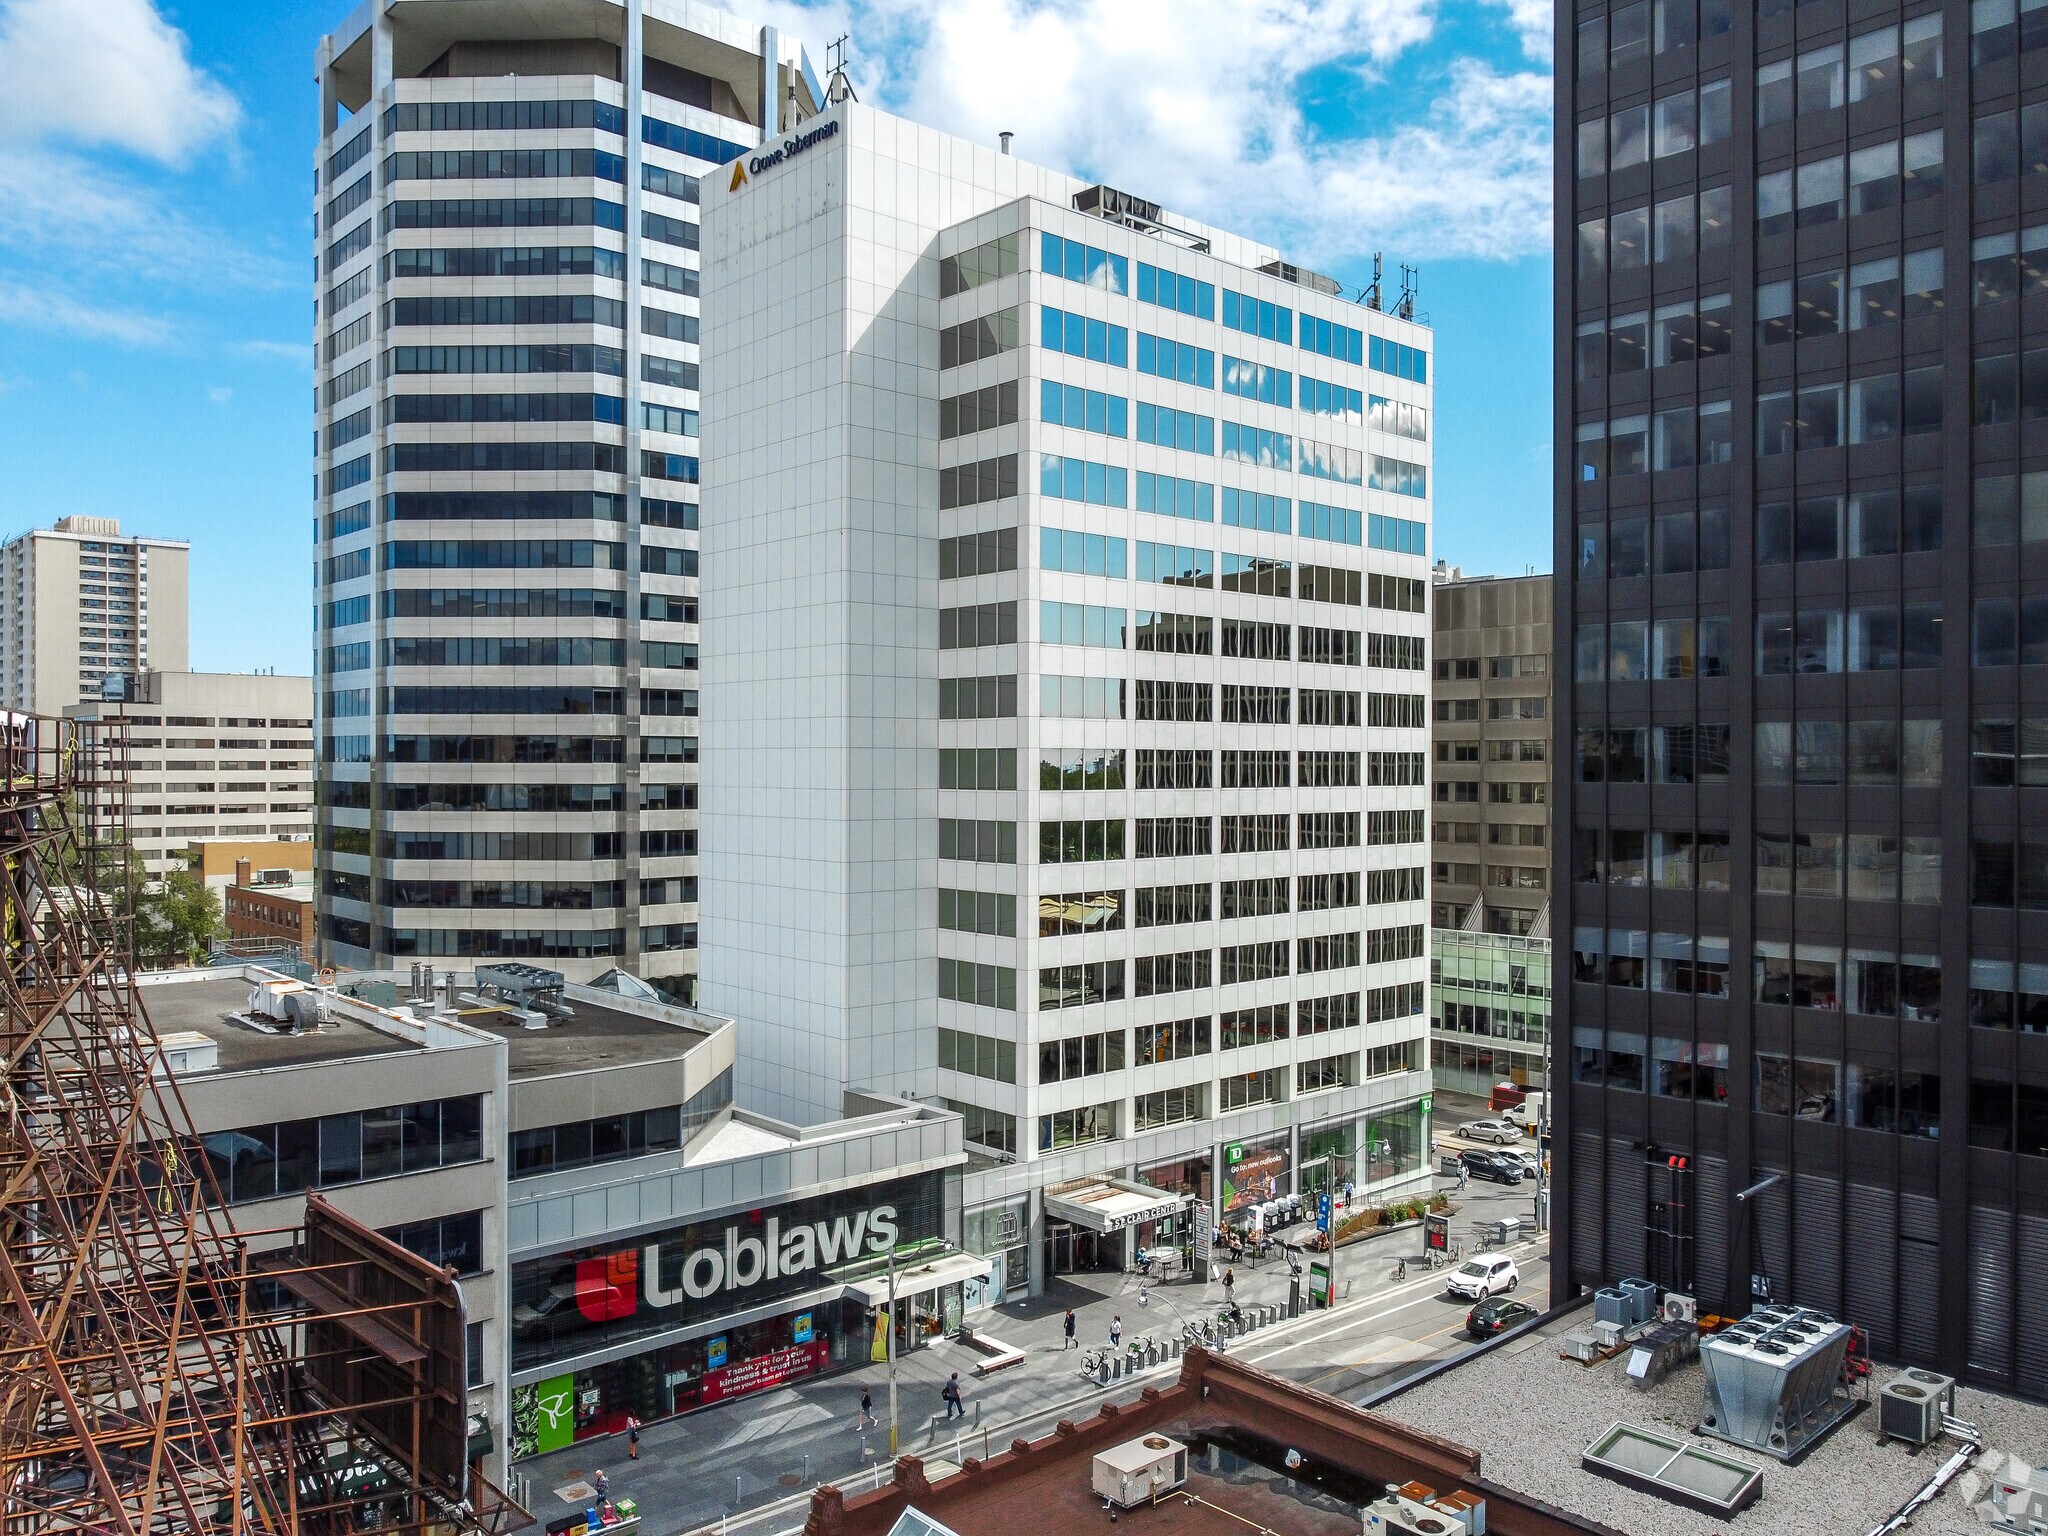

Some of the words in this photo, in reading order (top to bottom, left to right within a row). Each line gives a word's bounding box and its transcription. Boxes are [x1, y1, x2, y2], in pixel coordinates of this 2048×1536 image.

[749, 149, 783, 174] Crowe
[784, 120, 839, 158] Soberman
[1423, 1099, 1431, 1110] TD
[1230, 1166, 1239, 1174] Go
[1248, 1161, 1259, 1169] new
[1259, 1154, 1282, 1166] outlooks
[1231, 1147, 1241, 1159] TD
[1127, 1211, 1150, 1224] CLAIR
[644, 1205, 899, 1308] Loblaws
[719, 1371, 760, 1388] kindness
[761, 1368, 769, 1376] &
[769, 1361, 791, 1373] trust
[792, 1357, 801, 1366] in
[801, 1355, 812, 1363] us
[727, 1364, 754, 1377] Thank
[772, 1354, 785, 1364] for
[786, 1348, 805, 1361] your
[723, 1384, 741, 1394] From
[741, 1380, 756, 1390] your
[757, 1374, 775, 1385] team
[774, 1371, 782, 1379] at
[783, 1364, 809, 1376] Loblaws
